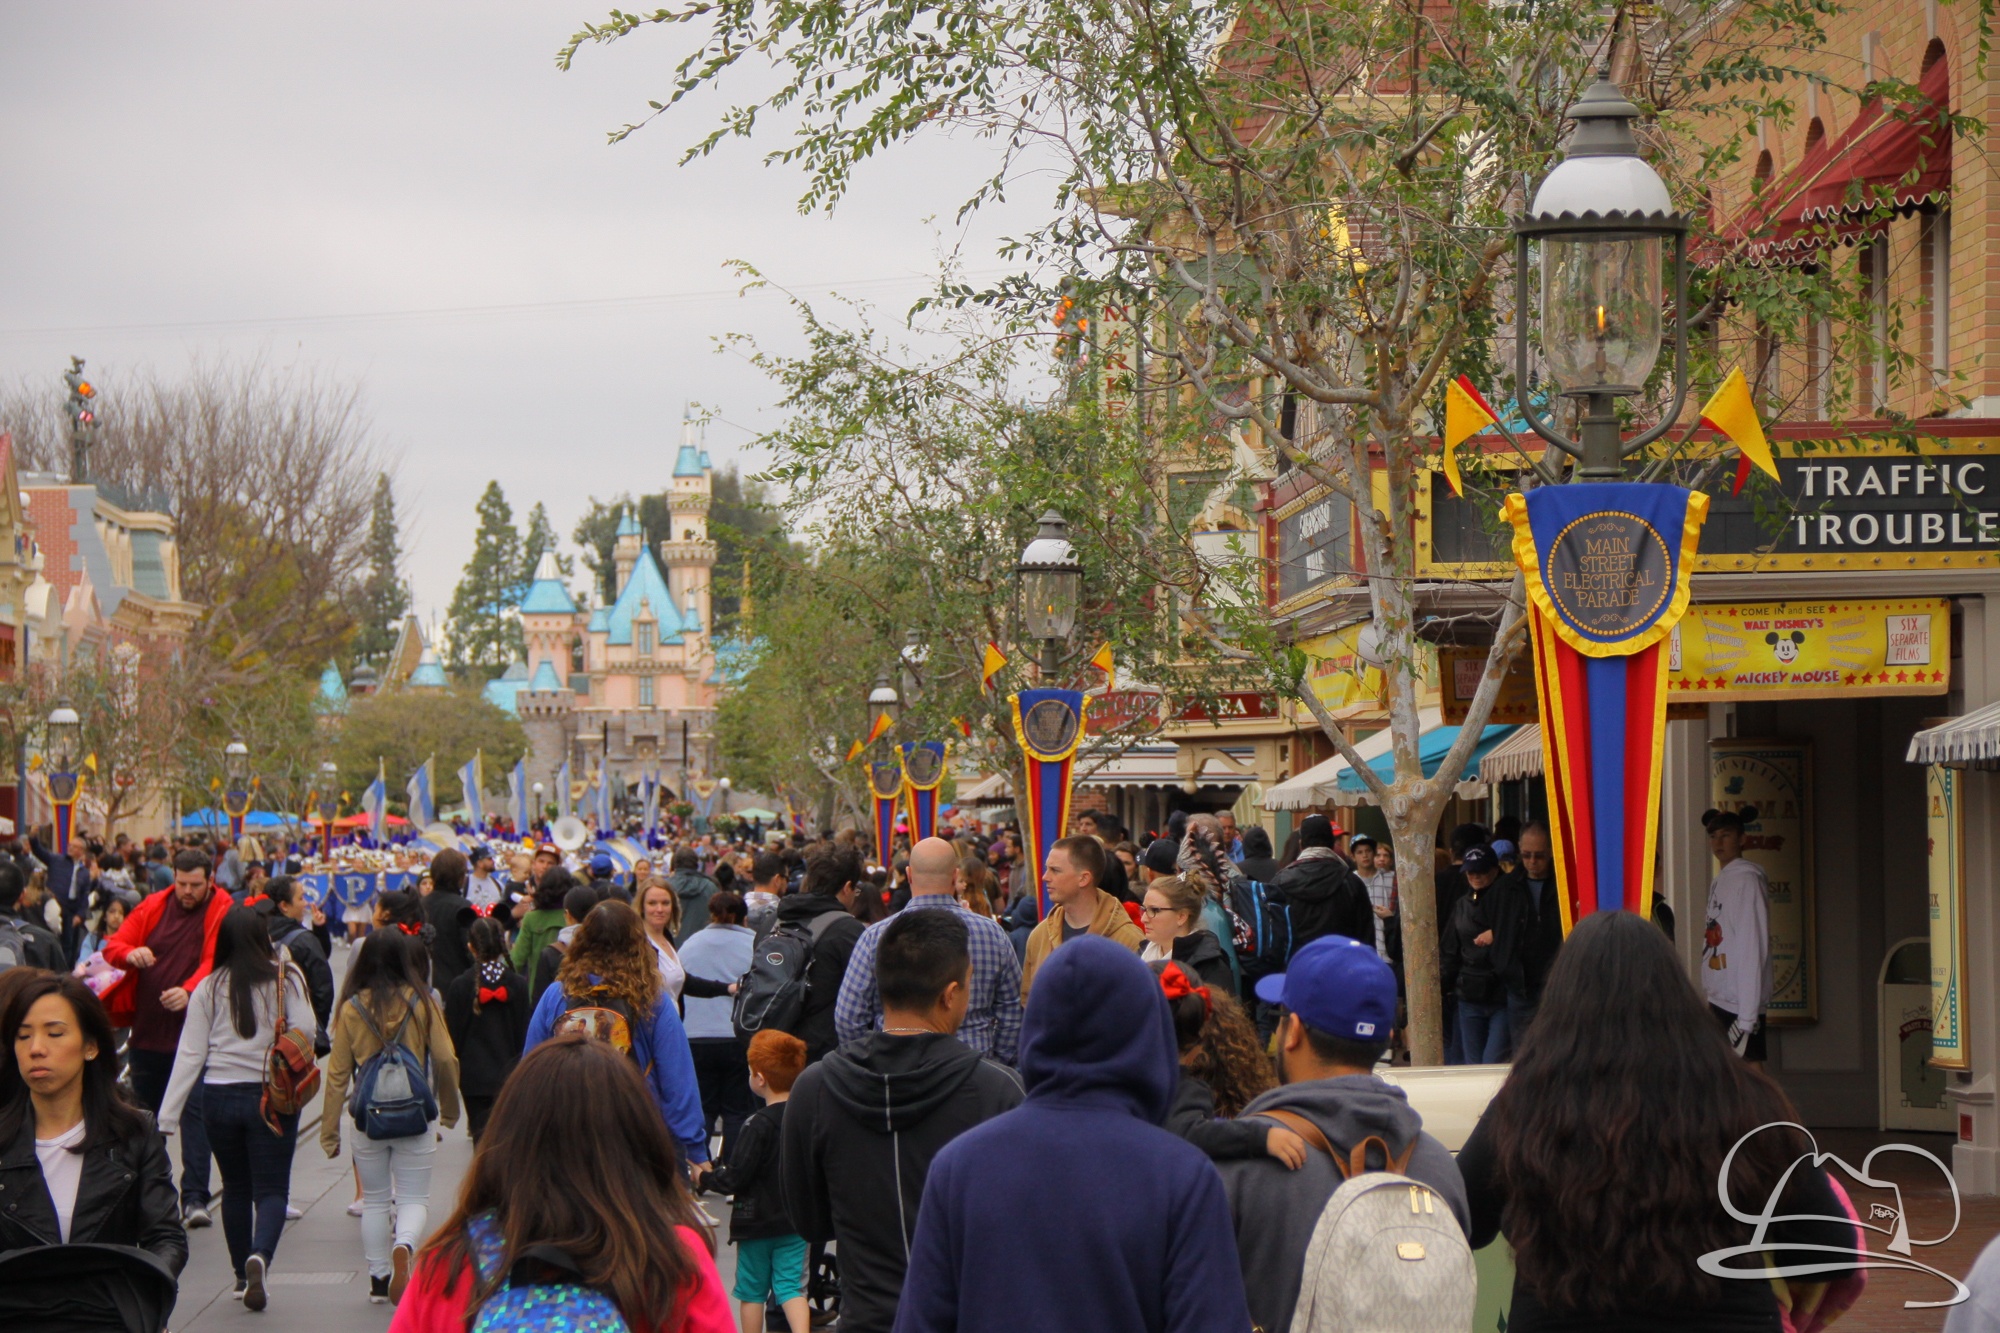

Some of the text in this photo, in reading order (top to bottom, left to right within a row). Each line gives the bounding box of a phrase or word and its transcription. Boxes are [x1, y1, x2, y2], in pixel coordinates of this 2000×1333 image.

[1798, 463, 1985, 496] TRAFFIC
[1790, 513, 2000, 545] TROUBLE
[1585, 537, 1630, 554] MAIN
[1579, 553, 1637, 572] STREET
[1563, 570, 1655, 589] ELECTRICAL
[1576, 589, 1640, 608] PARADE
[1741, 606, 1825, 616] COME IN and SEE
[1743, 618, 1824, 631] WALT DISNEY'S
[1901, 618, 1918, 630] SIX
[1890, 632, 1929, 647] SEPARATE
[1895, 648, 1920, 661] FILMS
[1734, 670, 1840, 684] MICKEY MOUSE
[1768, 882, 1791, 894] SIX
